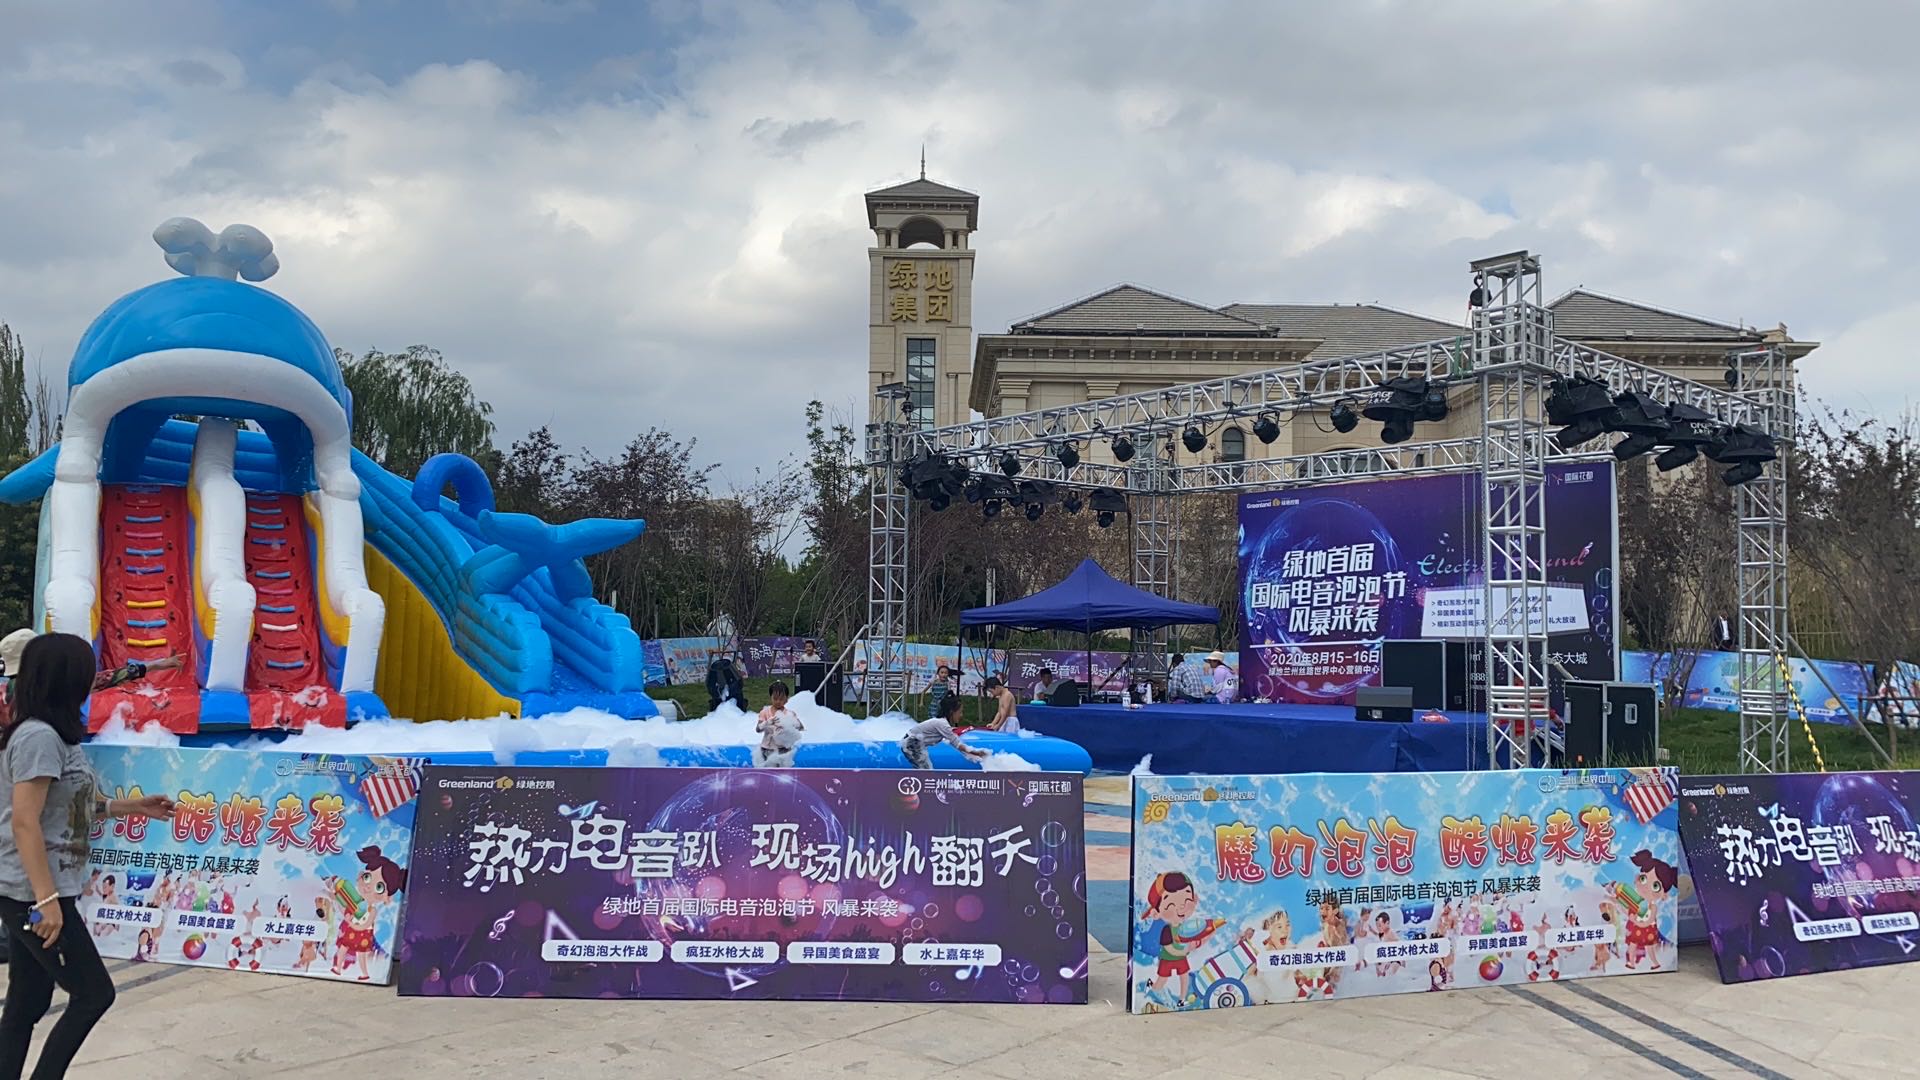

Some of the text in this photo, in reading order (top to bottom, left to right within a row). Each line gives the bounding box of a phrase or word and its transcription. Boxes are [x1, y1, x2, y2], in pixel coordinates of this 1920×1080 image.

[889, 260, 953, 291] 绿地
[890, 293, 952, 322] 集团
[1246, 501, 1272, 509] Greenland
[1282, 543, 1375, 578] 绿地首届
[1251, 571, 1407, 610] 国际电音泡泡节
[1289, 606, 1379, 636] 风暴来袭
[1270, 650, 1380, 666] 2020年8月15-16日
[438, 778, 494, 789] Greenland
[516, 780, 556, 790] 绿地控股
[1028, 780, 1072, 793] 国际花都
[1682, 787, 1716, 797] Greenland
[1151, 792, 1201, 802] Greenland
[173, 790, 346, 854] 酷炫来袭
[464, 813, 721, 886] 热力电音趴
[1214, 806, 1618, 883] 魔幻泡泡 酷炫来袭
[1717, 813, 1920, 879] 热力电音趴 现场
[201, 855, 261, 876] 风暴来袭
[1305, 876, 1541, 907] 绿地首届国际电音泡泡节 风暴来袭
[96, 907, 152, 924] 疯狂水枪大战
[602, 897, 899, 918] 绿地首届国际电音泡泡节 风暴来袭
[178, 914, 237, 931] 异国美食盛宴
[264, 922, 316, 937] 水上嘉年华
[1468, 936, 1528, 951] 异国美食盛宴
[1557, 928, 1605, 943] 水上嘉年华
[556, 944, 649, 958] 奇幻泡泡大作战
[685, 945, 764, 959] 疯狂水枪大战
[802, 946, 881, 961] 异国美食盛宴
[919, 947, 985, 962] 水上嘉年华
[1269, 950, 1347, 967] 奇幻泡泡大作战
[1376, 942, 1440, 959] 疯狂水枪大战
